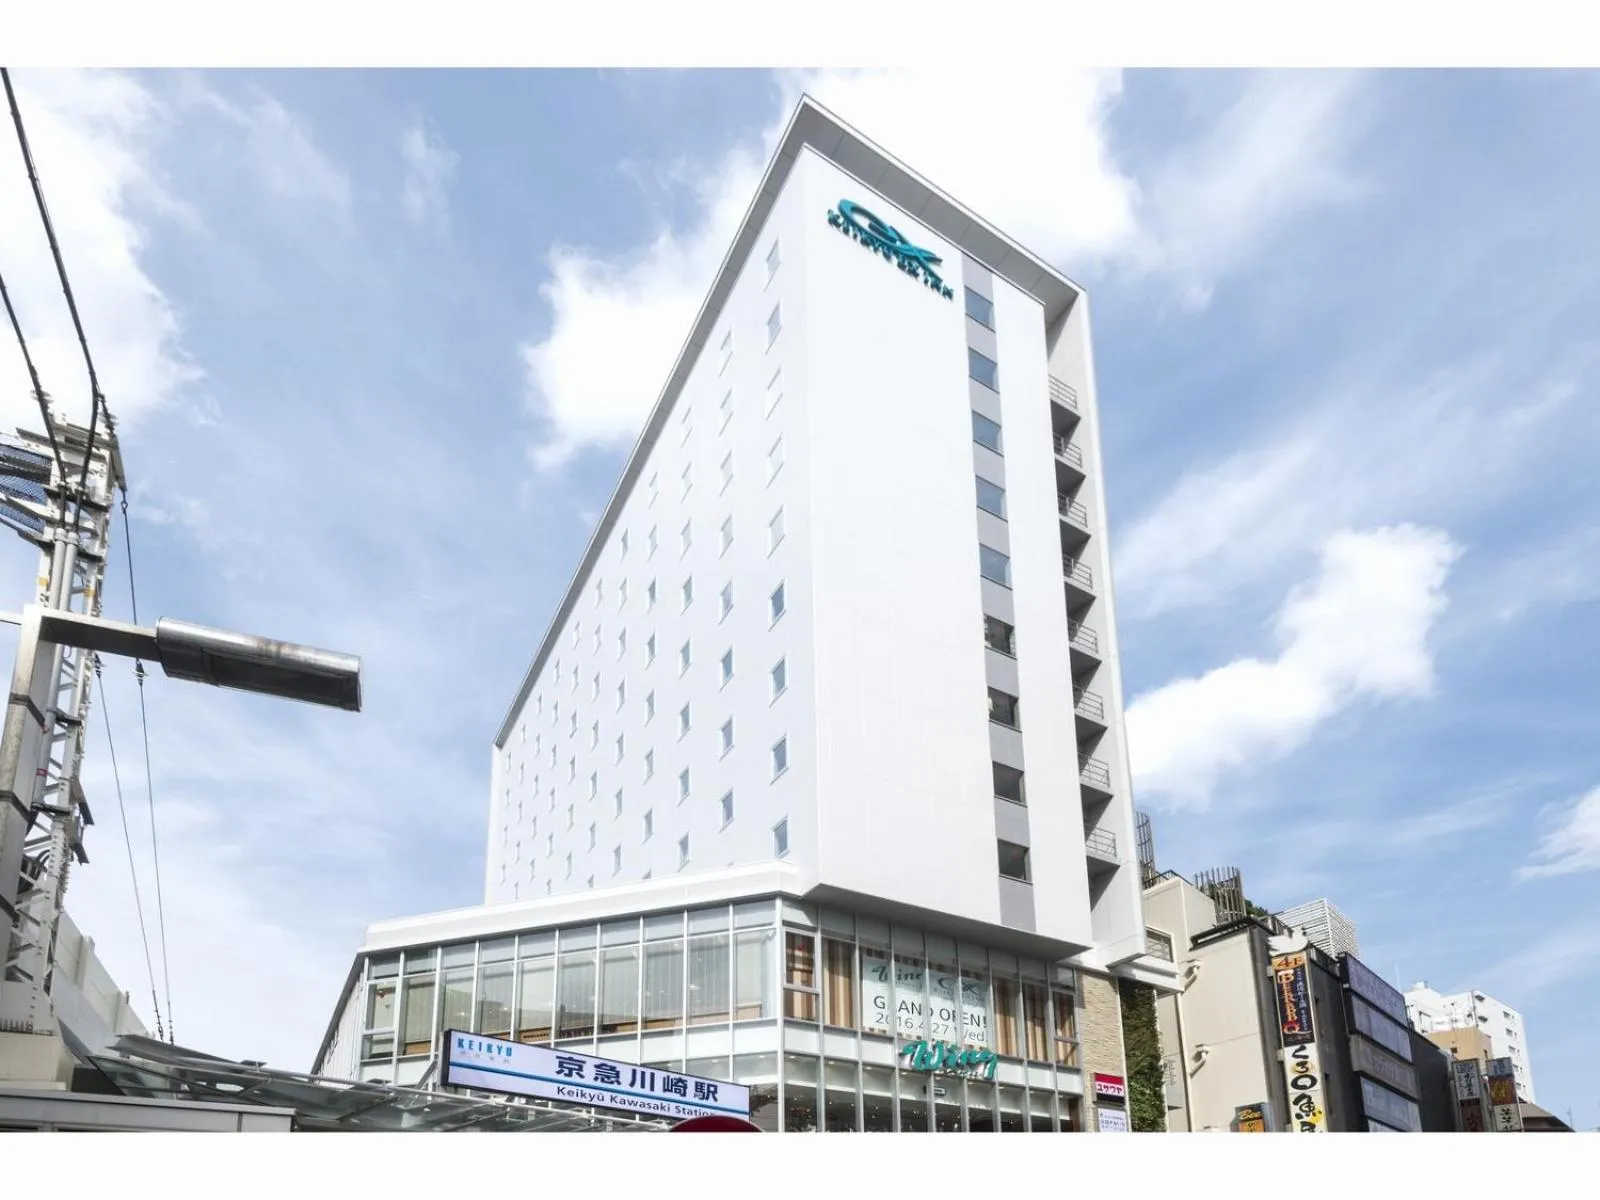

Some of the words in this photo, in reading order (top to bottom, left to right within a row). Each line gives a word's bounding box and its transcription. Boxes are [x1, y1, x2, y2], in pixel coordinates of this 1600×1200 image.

[873, 995, 934, 1017] GAN
[457, 1037, 513, 1057] KEIKYU
[900, 1040, 997, 1081] Wing
[555, 1055, 719, 1102] 京急川崎駅
[609, 1095, 672, 1113] Kawasaki
